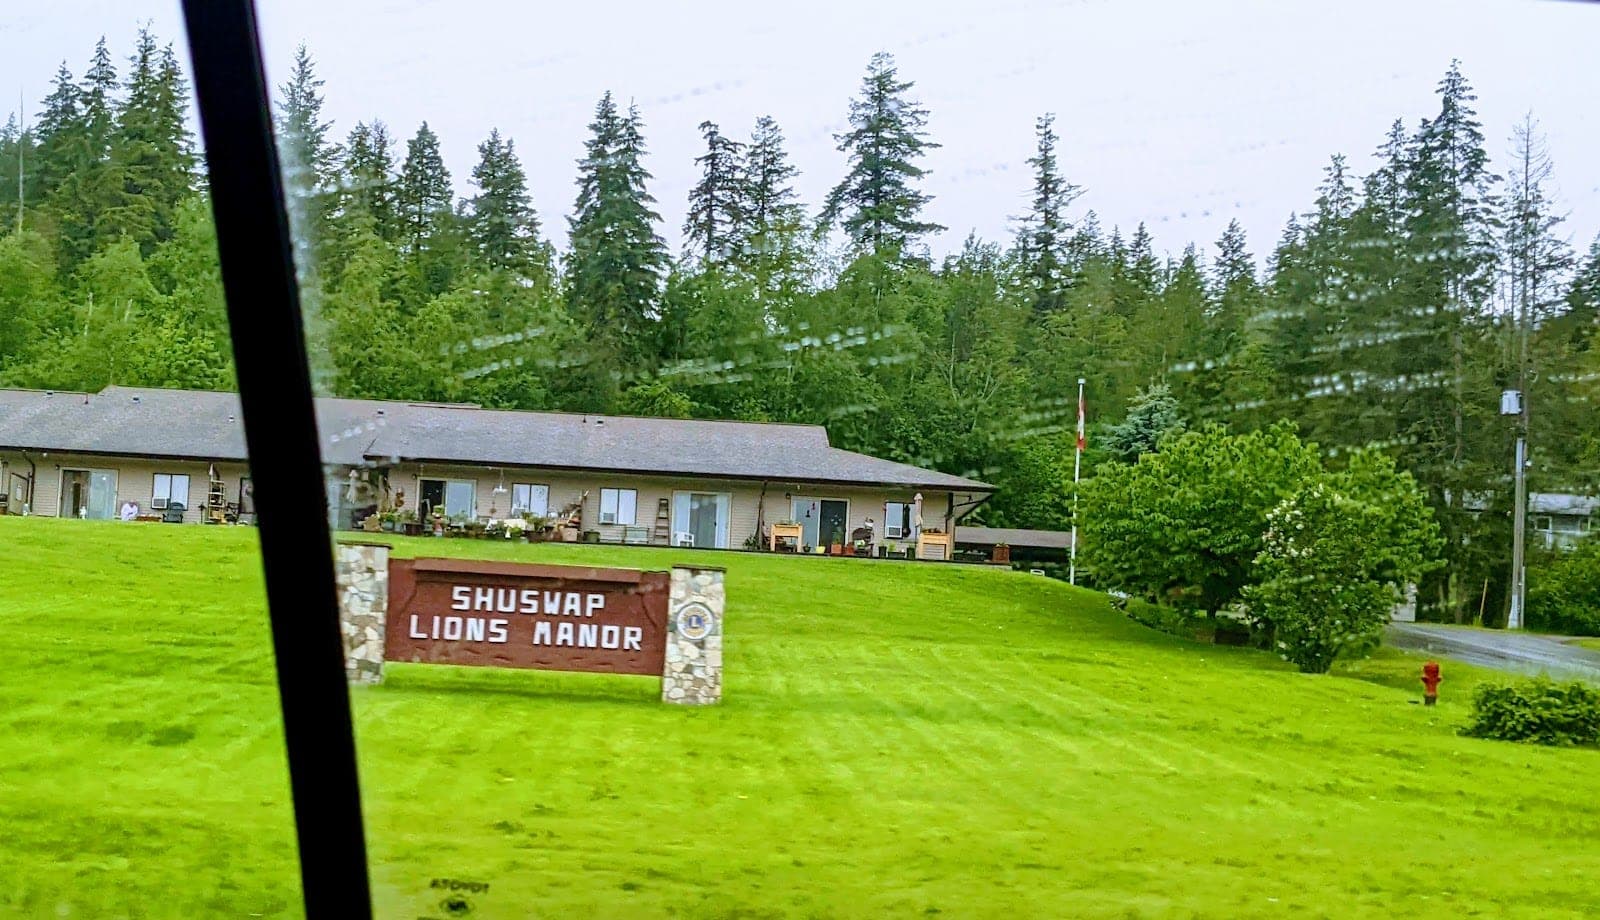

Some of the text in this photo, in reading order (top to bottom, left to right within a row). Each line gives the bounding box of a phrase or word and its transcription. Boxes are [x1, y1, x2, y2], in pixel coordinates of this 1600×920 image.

[451, 585, 605, 617] SHUSWAP
[409, 614, 642, 651] LIONS MANOR
